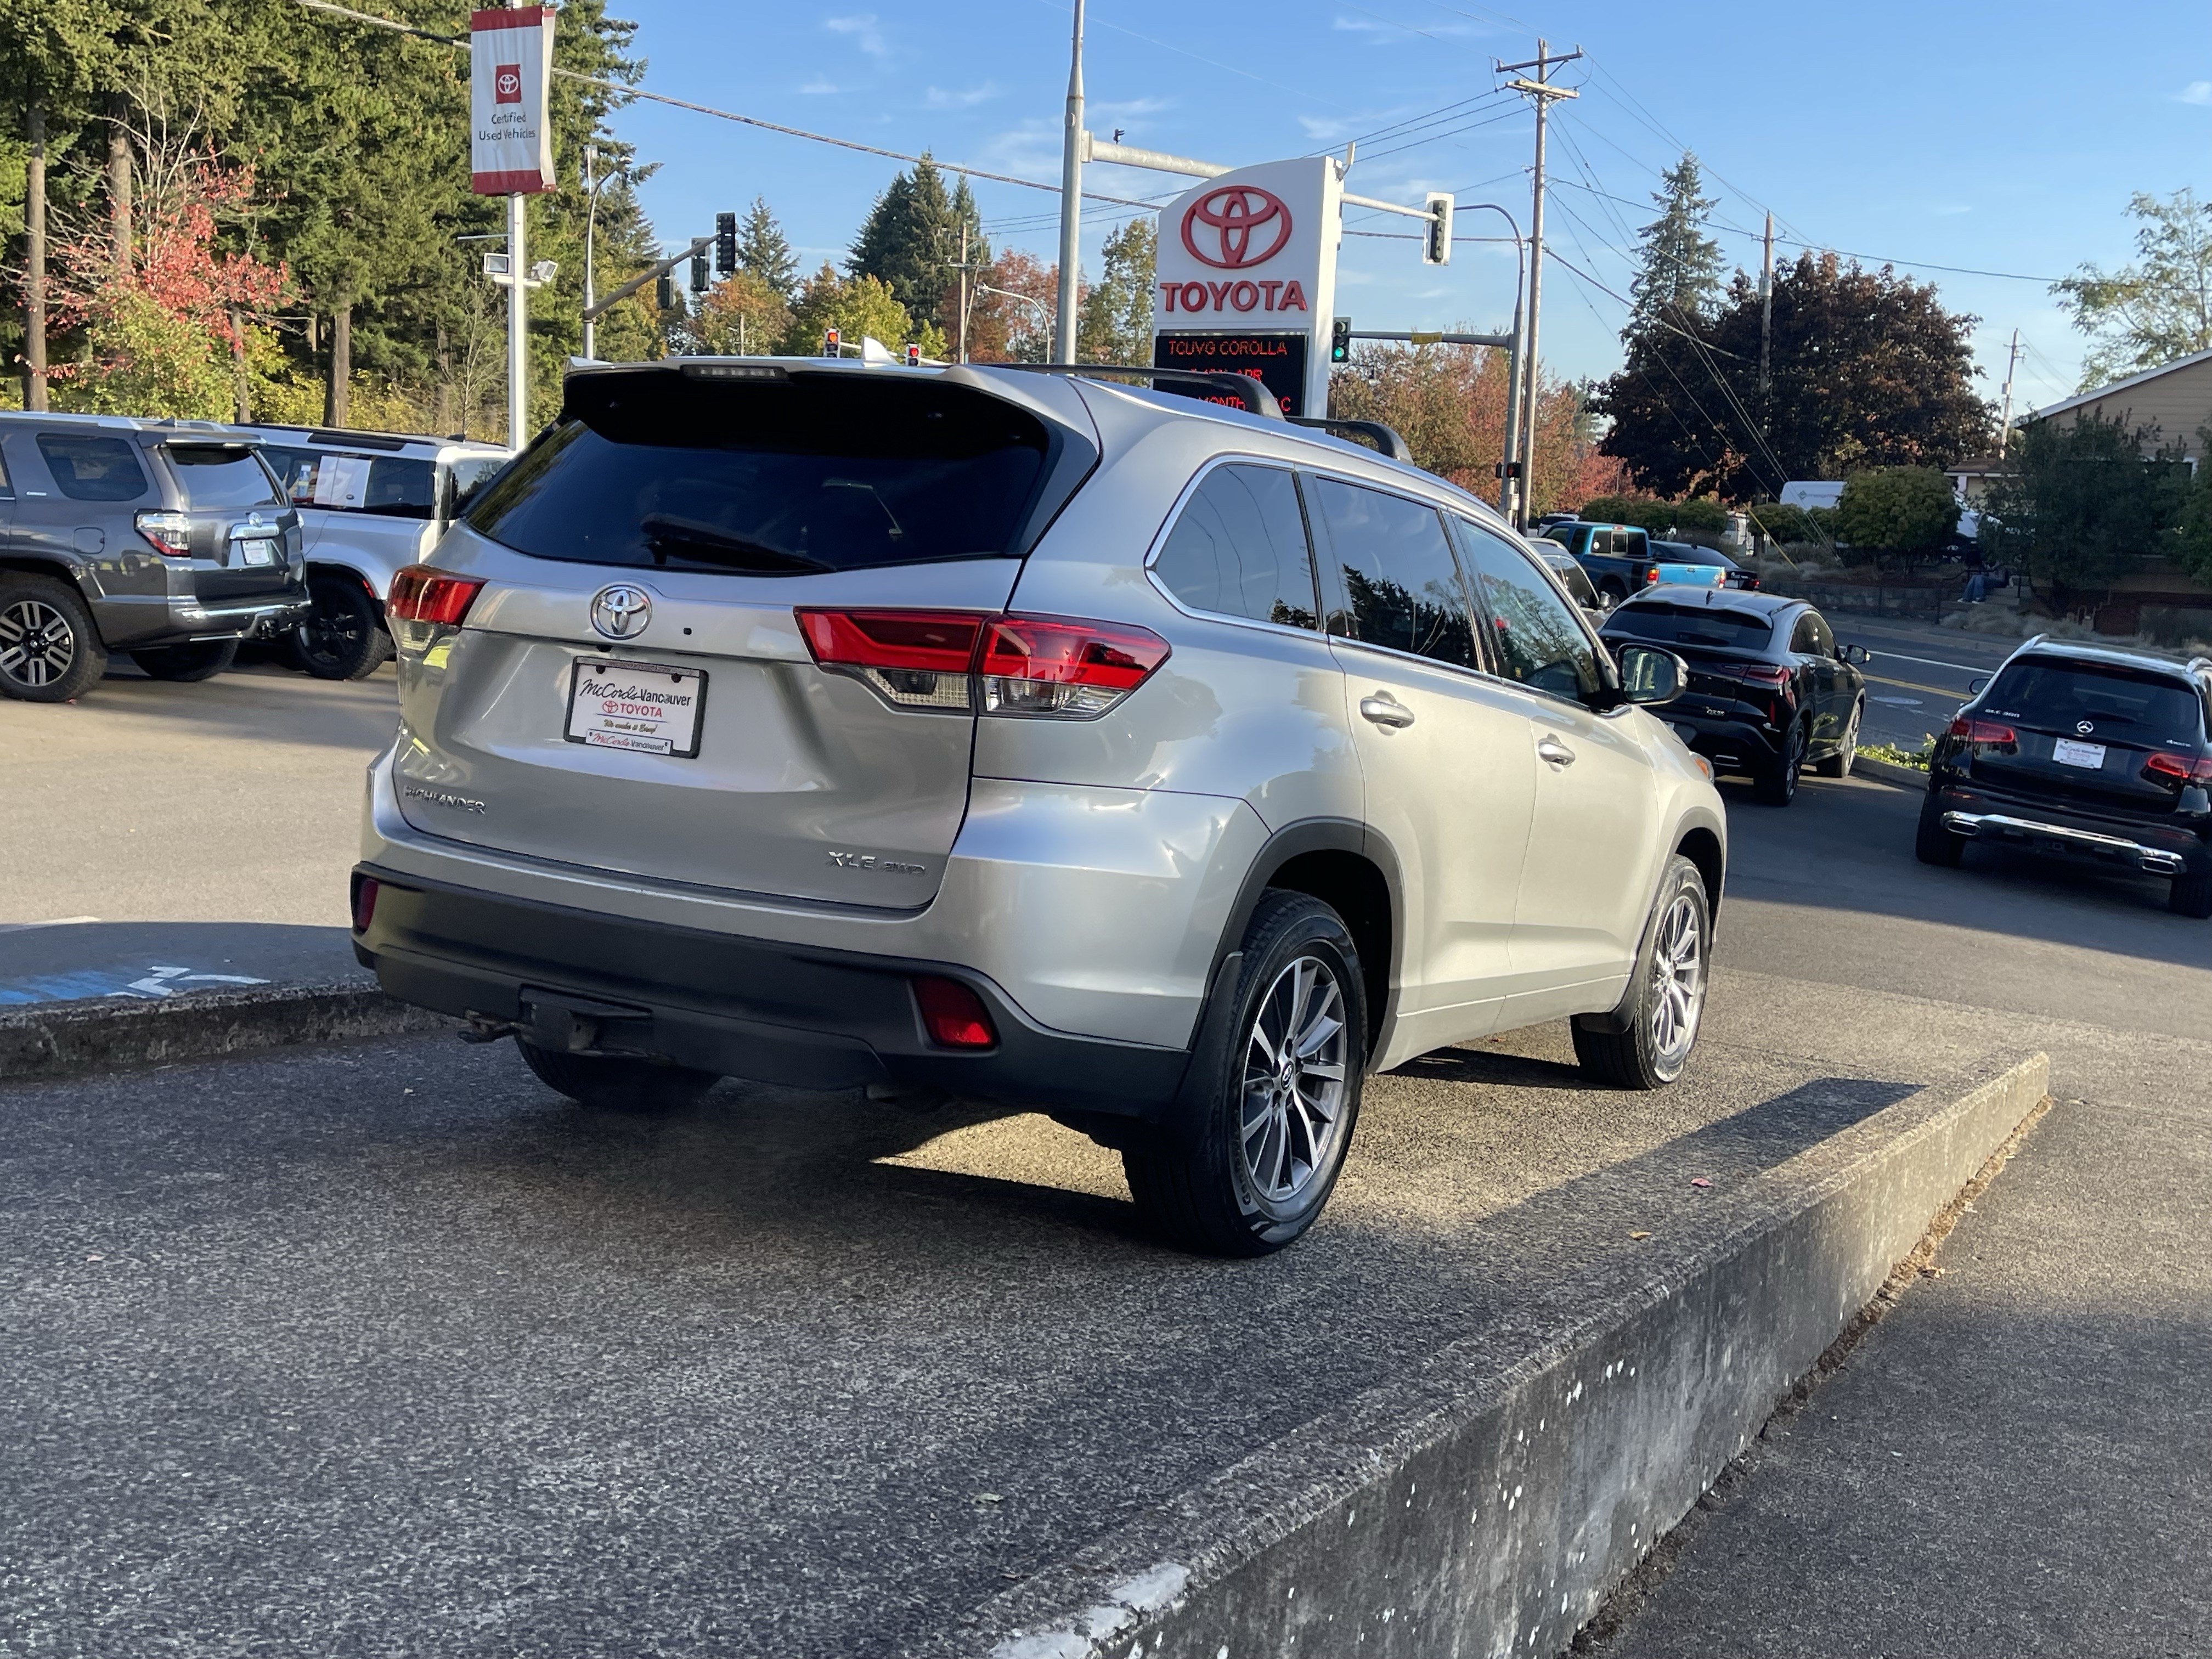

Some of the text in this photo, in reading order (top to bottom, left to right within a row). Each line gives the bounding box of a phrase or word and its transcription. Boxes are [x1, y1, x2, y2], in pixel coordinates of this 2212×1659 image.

[491, 112, 526, 124] Certified
[479, 128, 535, 140] Used Vehicles
[1160, 280, 1308, 312] TOYOTA
[1219, 340, 1288, 356] COROLLA
[620, 703, 663, 718] TOYOTA
[828, 851, 877, 870] XLE
